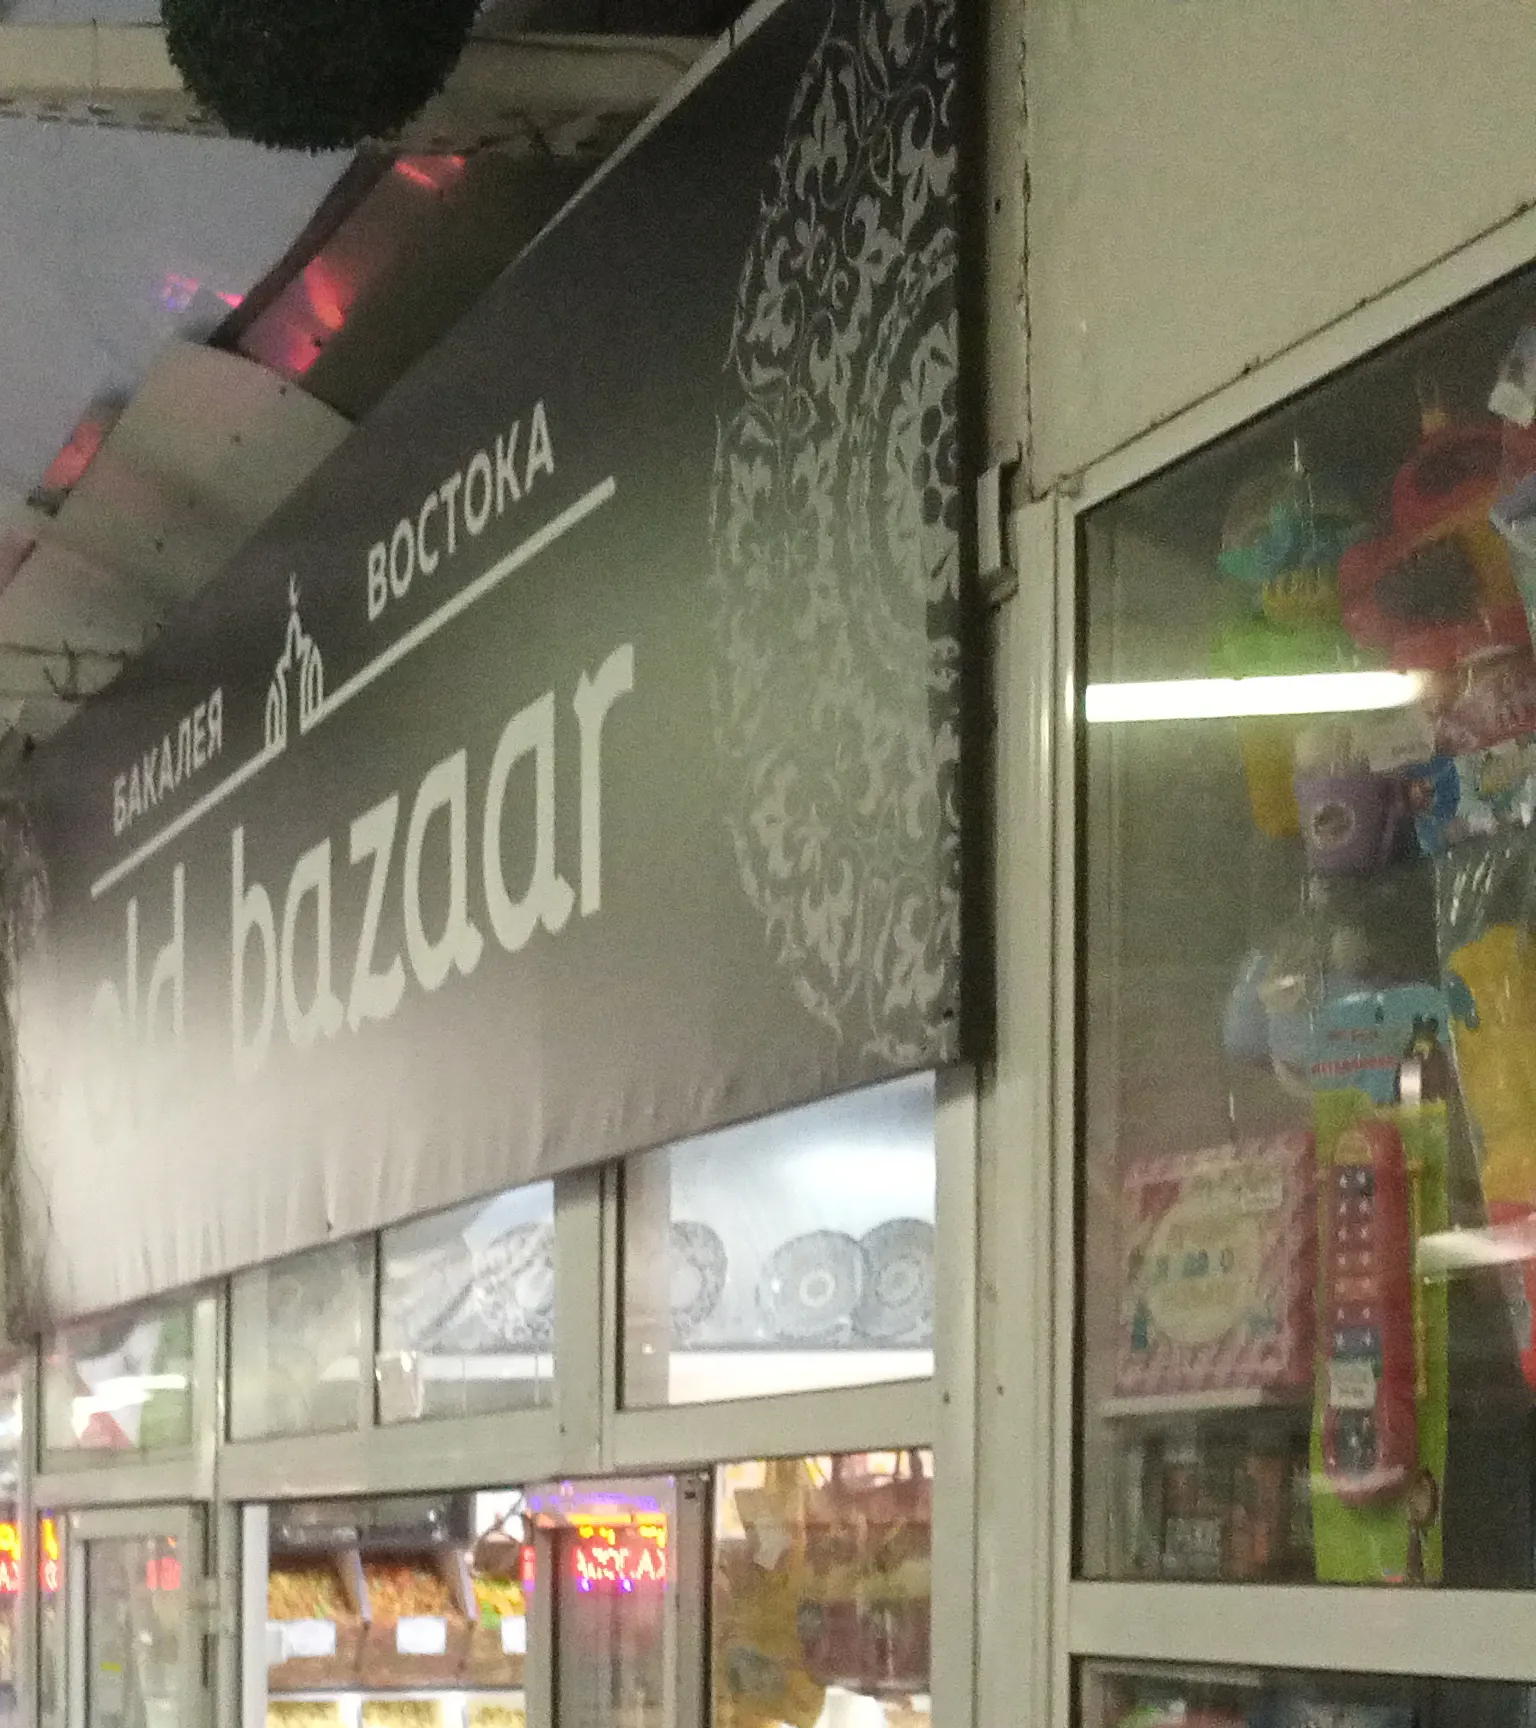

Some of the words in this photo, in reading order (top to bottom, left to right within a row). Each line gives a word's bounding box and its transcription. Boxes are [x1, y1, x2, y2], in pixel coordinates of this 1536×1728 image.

[112, 687, 224, 837] БАКАЛЕЯ
[367, 399, 555, 621] ВОСТОКА
[232, 644, 634, 1074] bazaar
